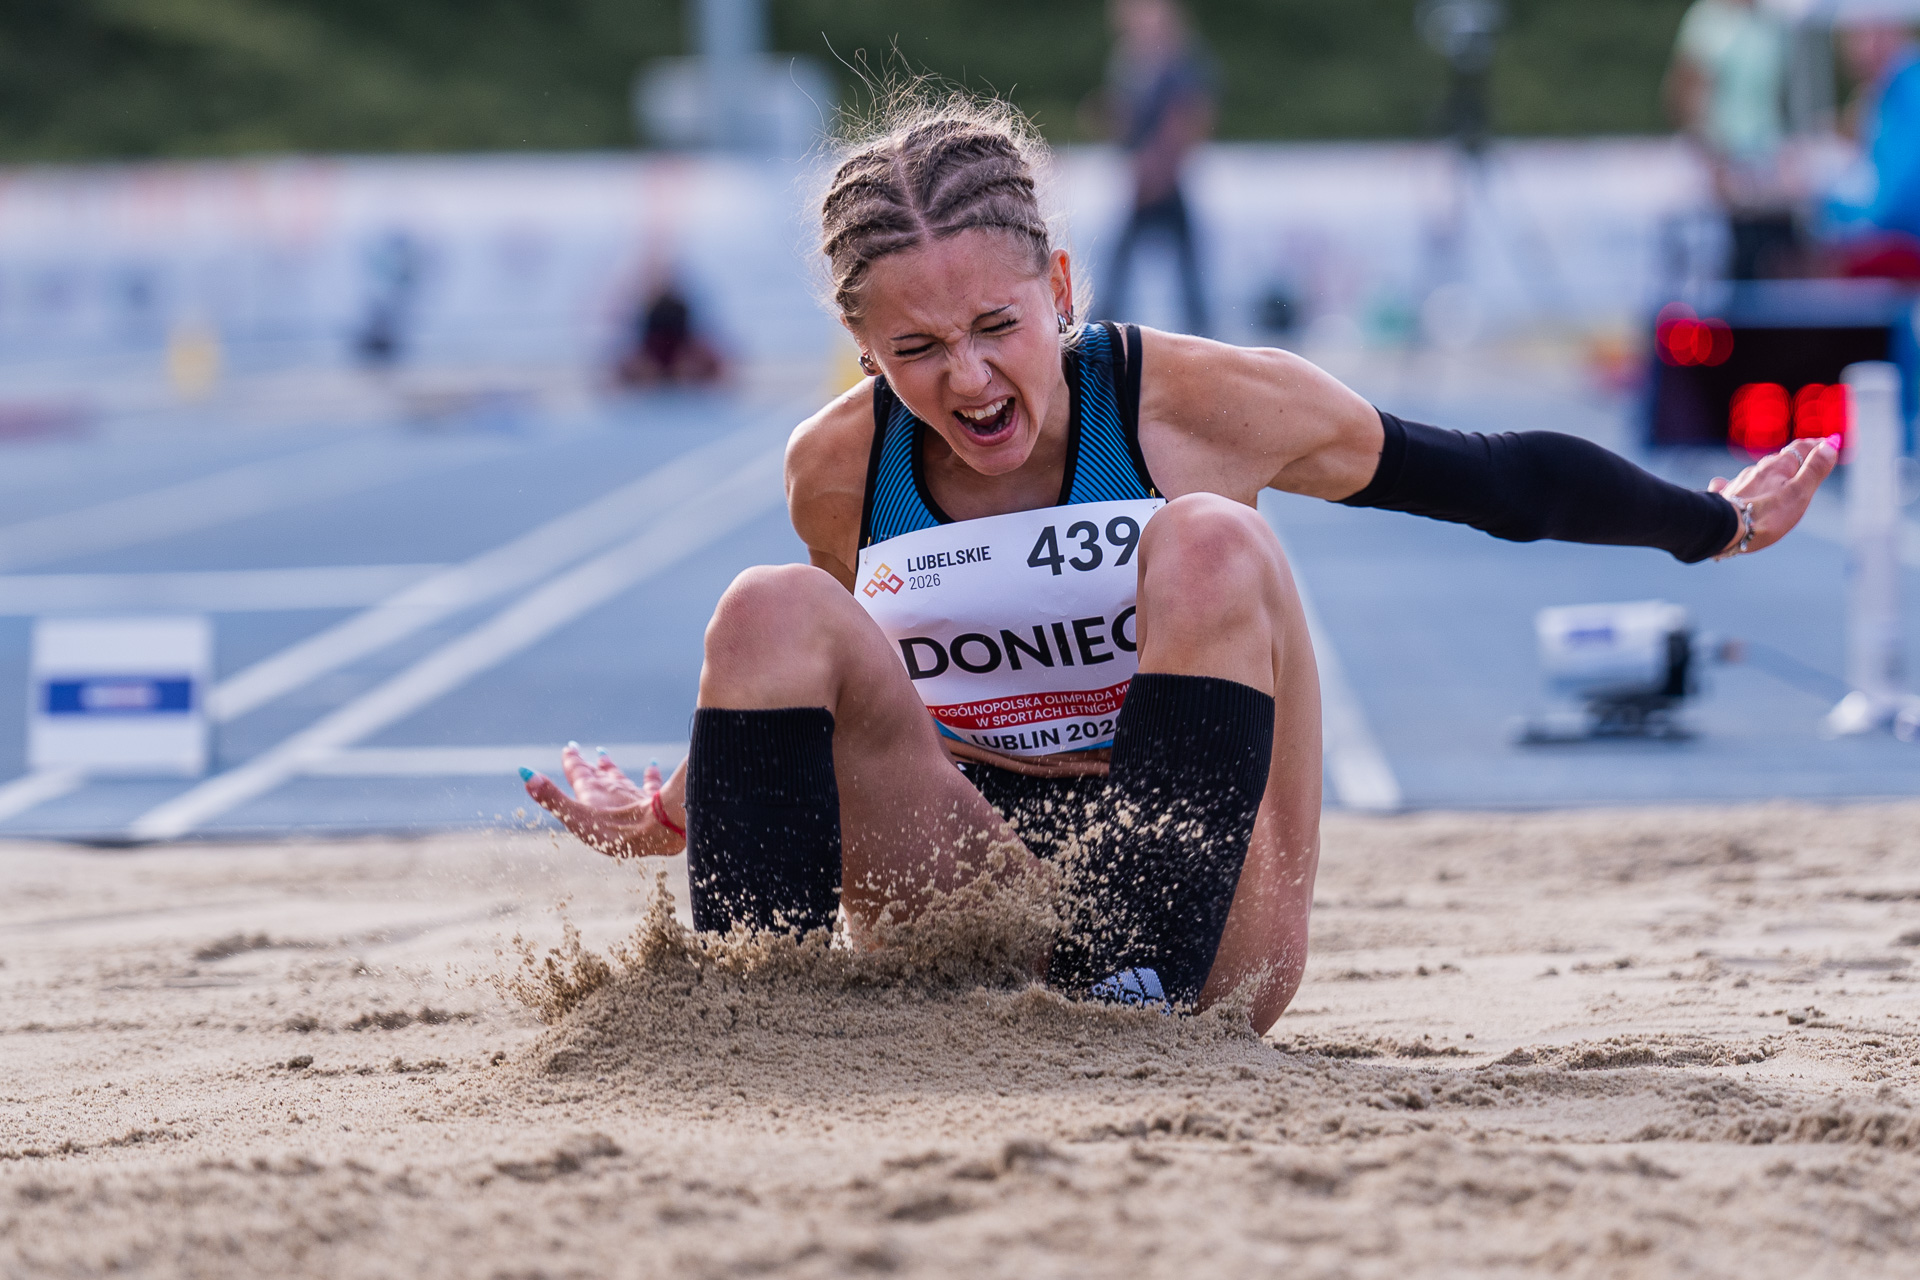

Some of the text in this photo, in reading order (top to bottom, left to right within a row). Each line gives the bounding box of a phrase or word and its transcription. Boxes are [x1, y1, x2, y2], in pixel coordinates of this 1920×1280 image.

[907, 546, 992, 572] LUBELSKIE
[1026, 516, 1140, 576] 439
[909, 573, 941, 590] 2026
[938, 697, 1042, 718] OGÓLNOPOLSKA
[1044, 690, 1113, 705] OLIMPIADA
[975, 700, 1117, 728] W SPORTACH LETNICH
[971, 719, 1117, 751] LUBLIN 202
